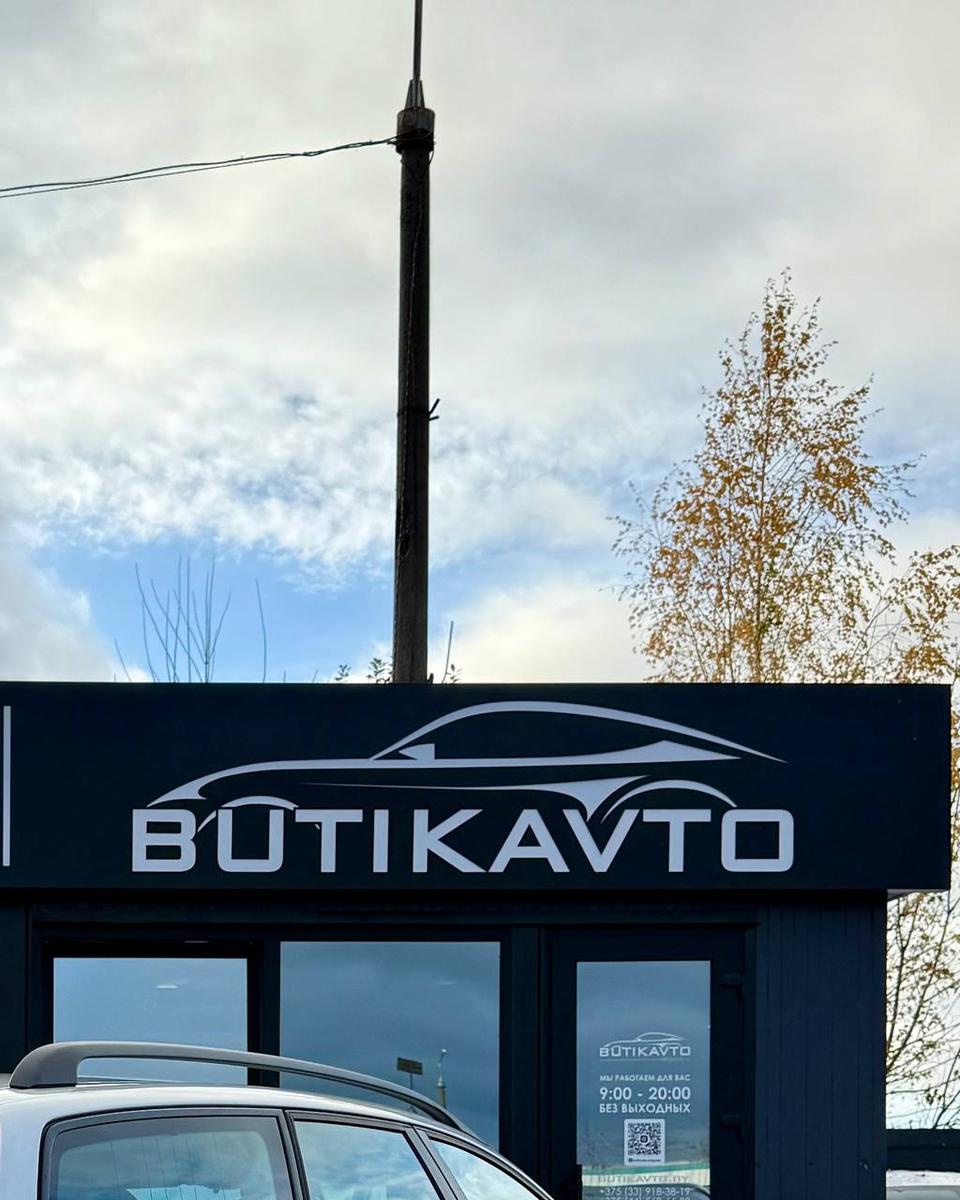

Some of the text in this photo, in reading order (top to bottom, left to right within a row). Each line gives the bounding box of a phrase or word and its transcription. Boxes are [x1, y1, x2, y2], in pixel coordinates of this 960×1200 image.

[132, 808, 794, 873] BUTIKAVTO
[599, 1046, 691, 1057] BUTIKAVTO
[599, 1073, 691, 1083] МЫ РАБОТАЕМ ДЛЯ ВАС
[599, 1086, 632, 1101] 9:00
[648, 1086, 691, 1101] 20:00
[599, 1103, 691, 1115] БЕЗ ВЫХОДНЫХ
